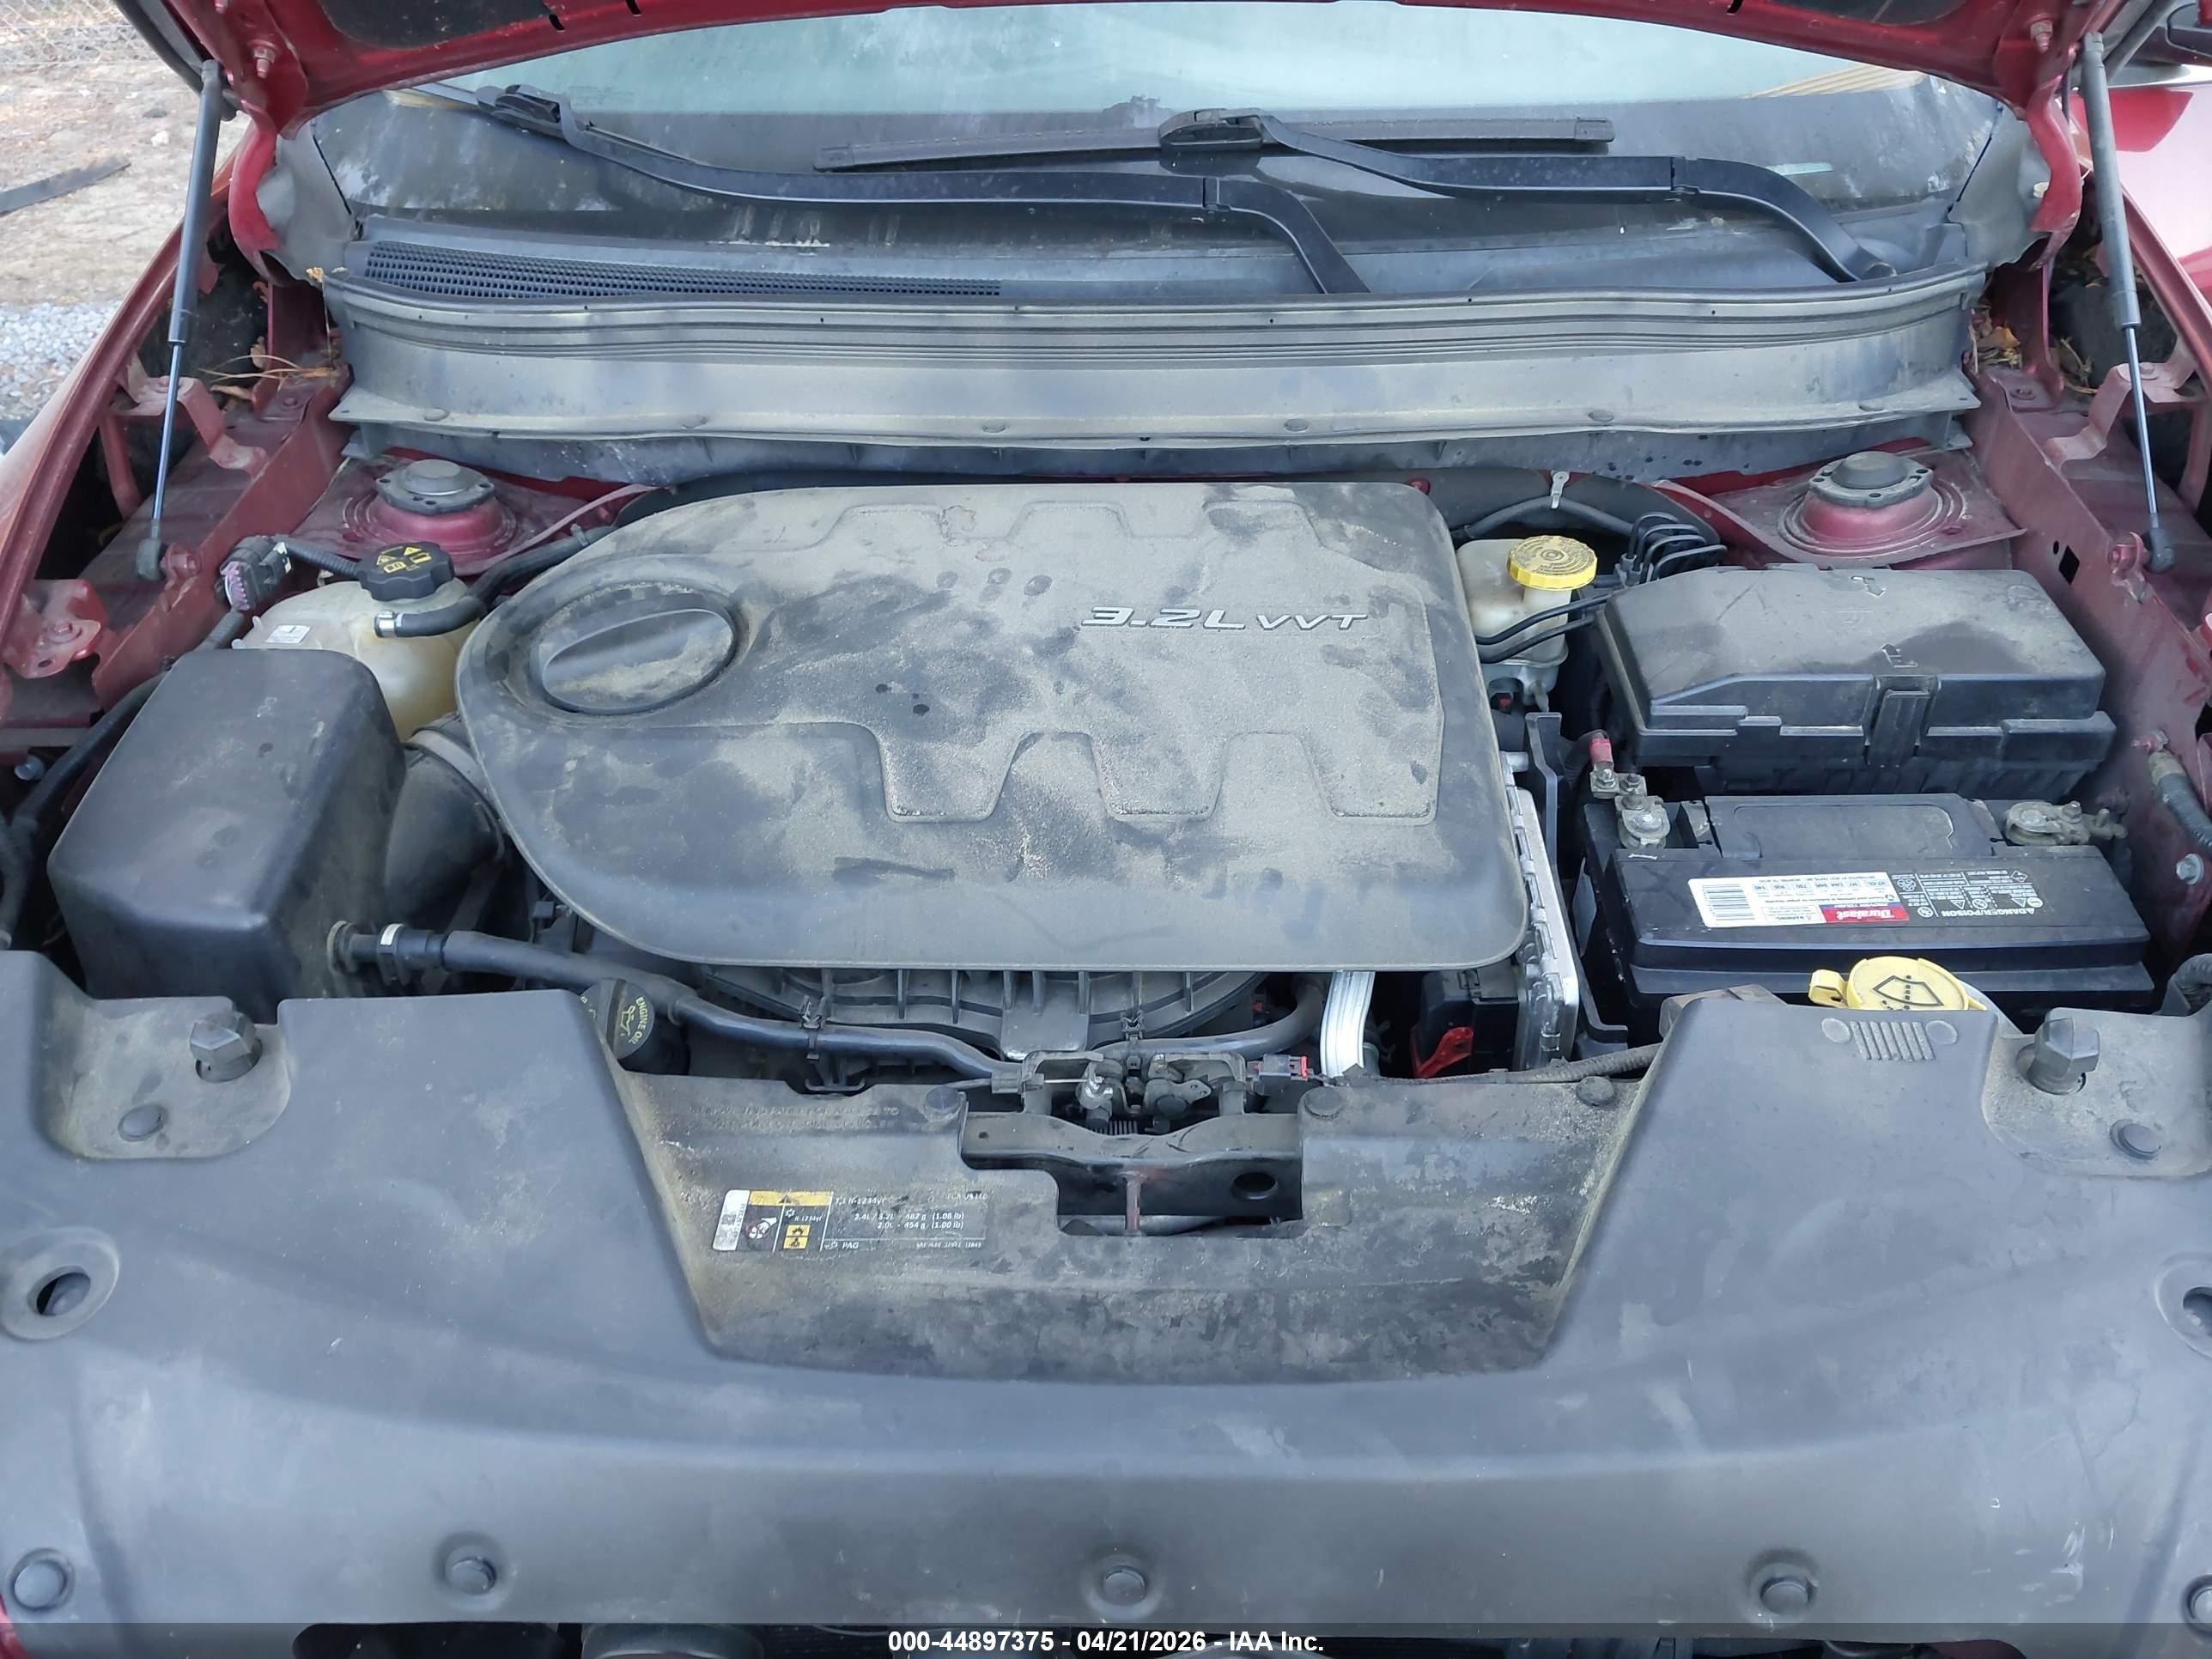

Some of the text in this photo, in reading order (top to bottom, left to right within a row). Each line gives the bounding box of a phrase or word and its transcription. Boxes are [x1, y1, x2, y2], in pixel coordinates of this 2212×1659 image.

[1082, 606, 1368, 630] 3.2L VVT
[1835, 908, 1894, 921] Duralast
[628, 996, 648, 1045] ENGINE OIL
